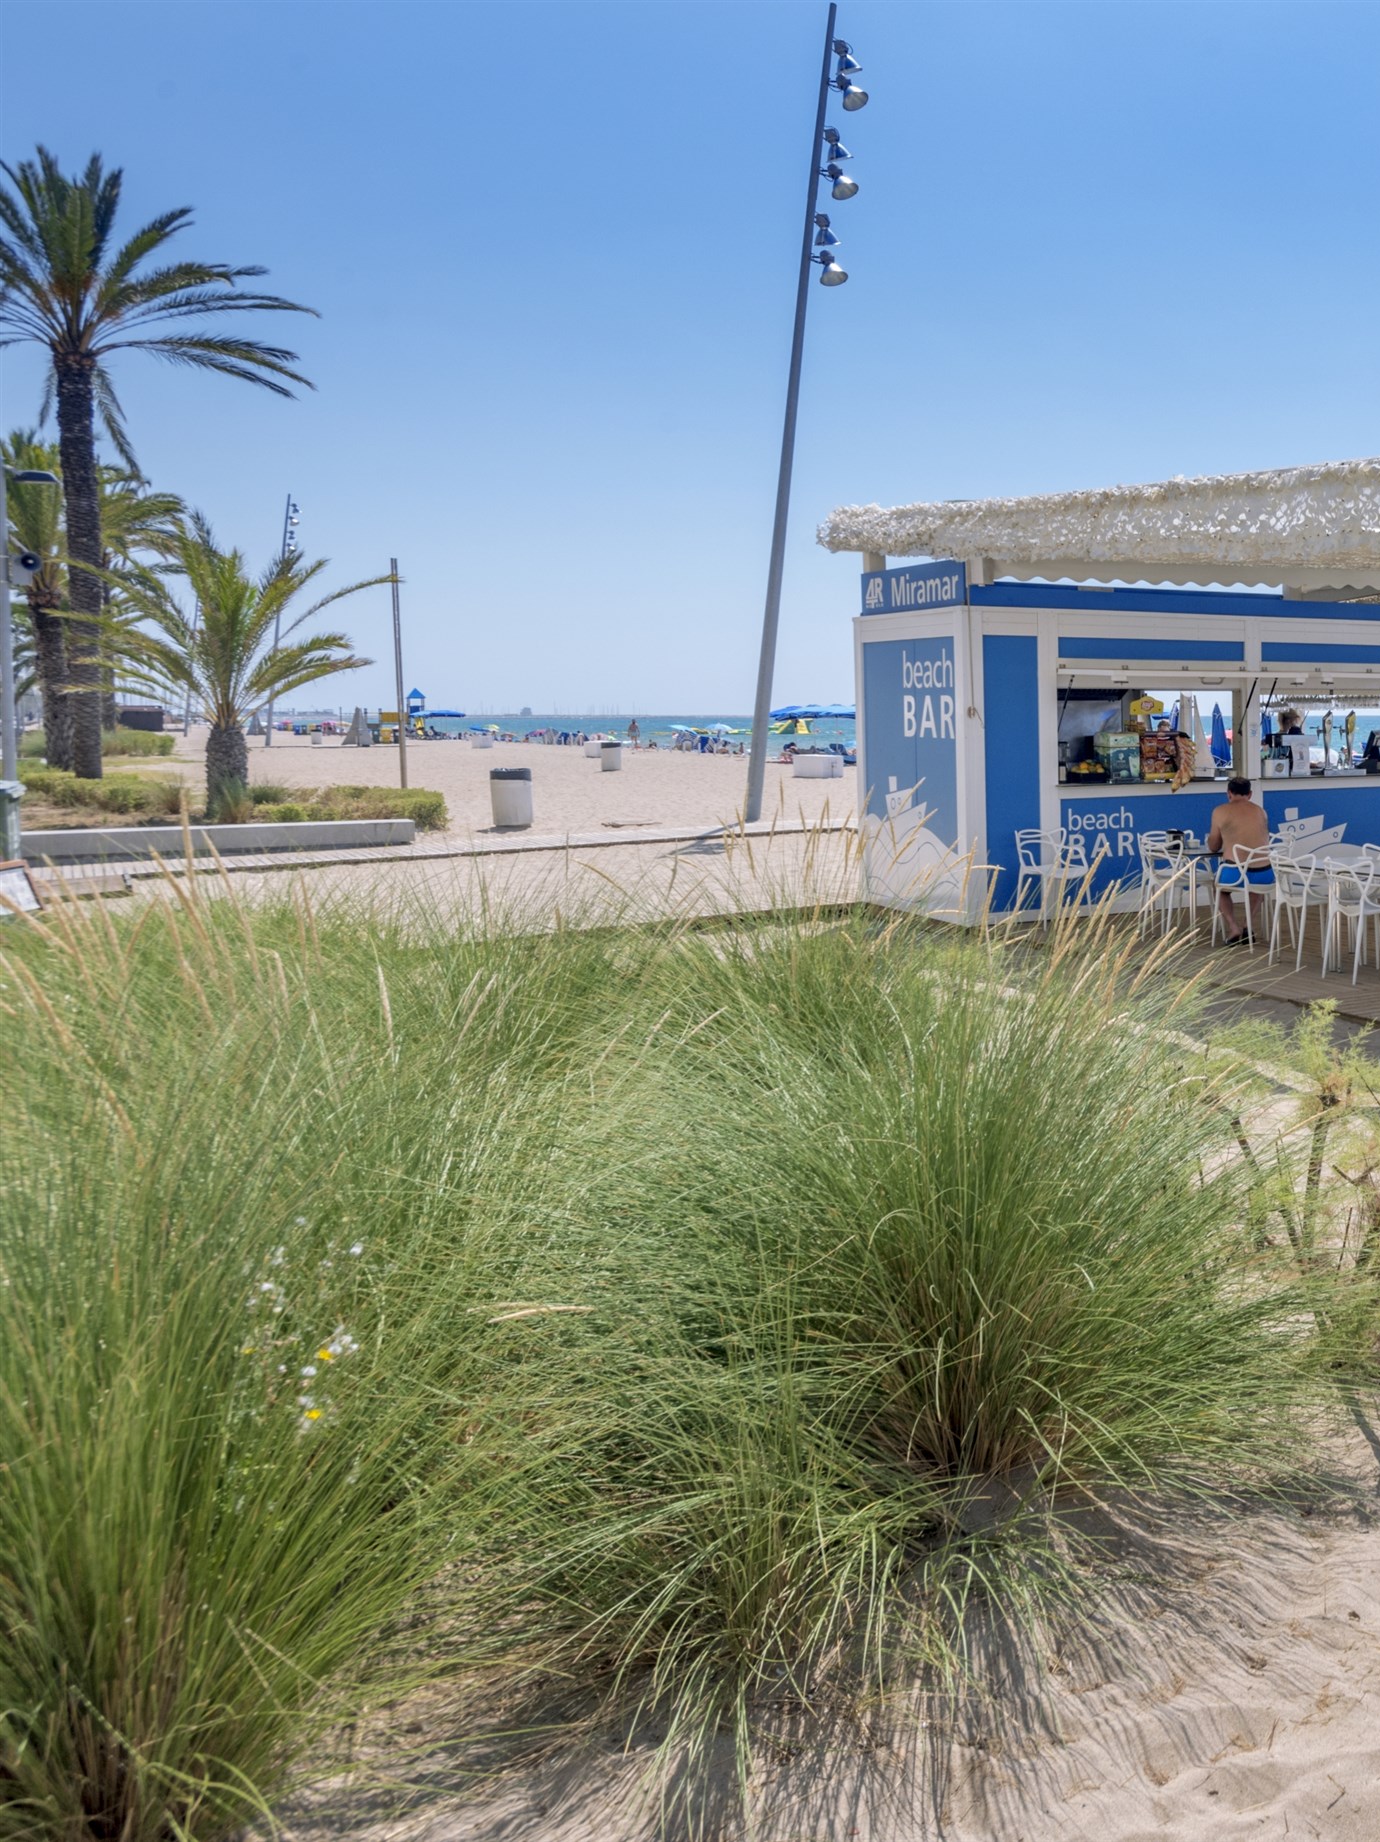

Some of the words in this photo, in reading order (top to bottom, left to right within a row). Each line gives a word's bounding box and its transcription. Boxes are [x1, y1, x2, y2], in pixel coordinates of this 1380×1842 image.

[891, 573, 959, 607] Miramar
[902, 647, 953, 689] beach
[903, 694, 956, 739] BAR
[1068, 805, 1134, 832] beach
[1068, 831, 1135, 860] BAR
